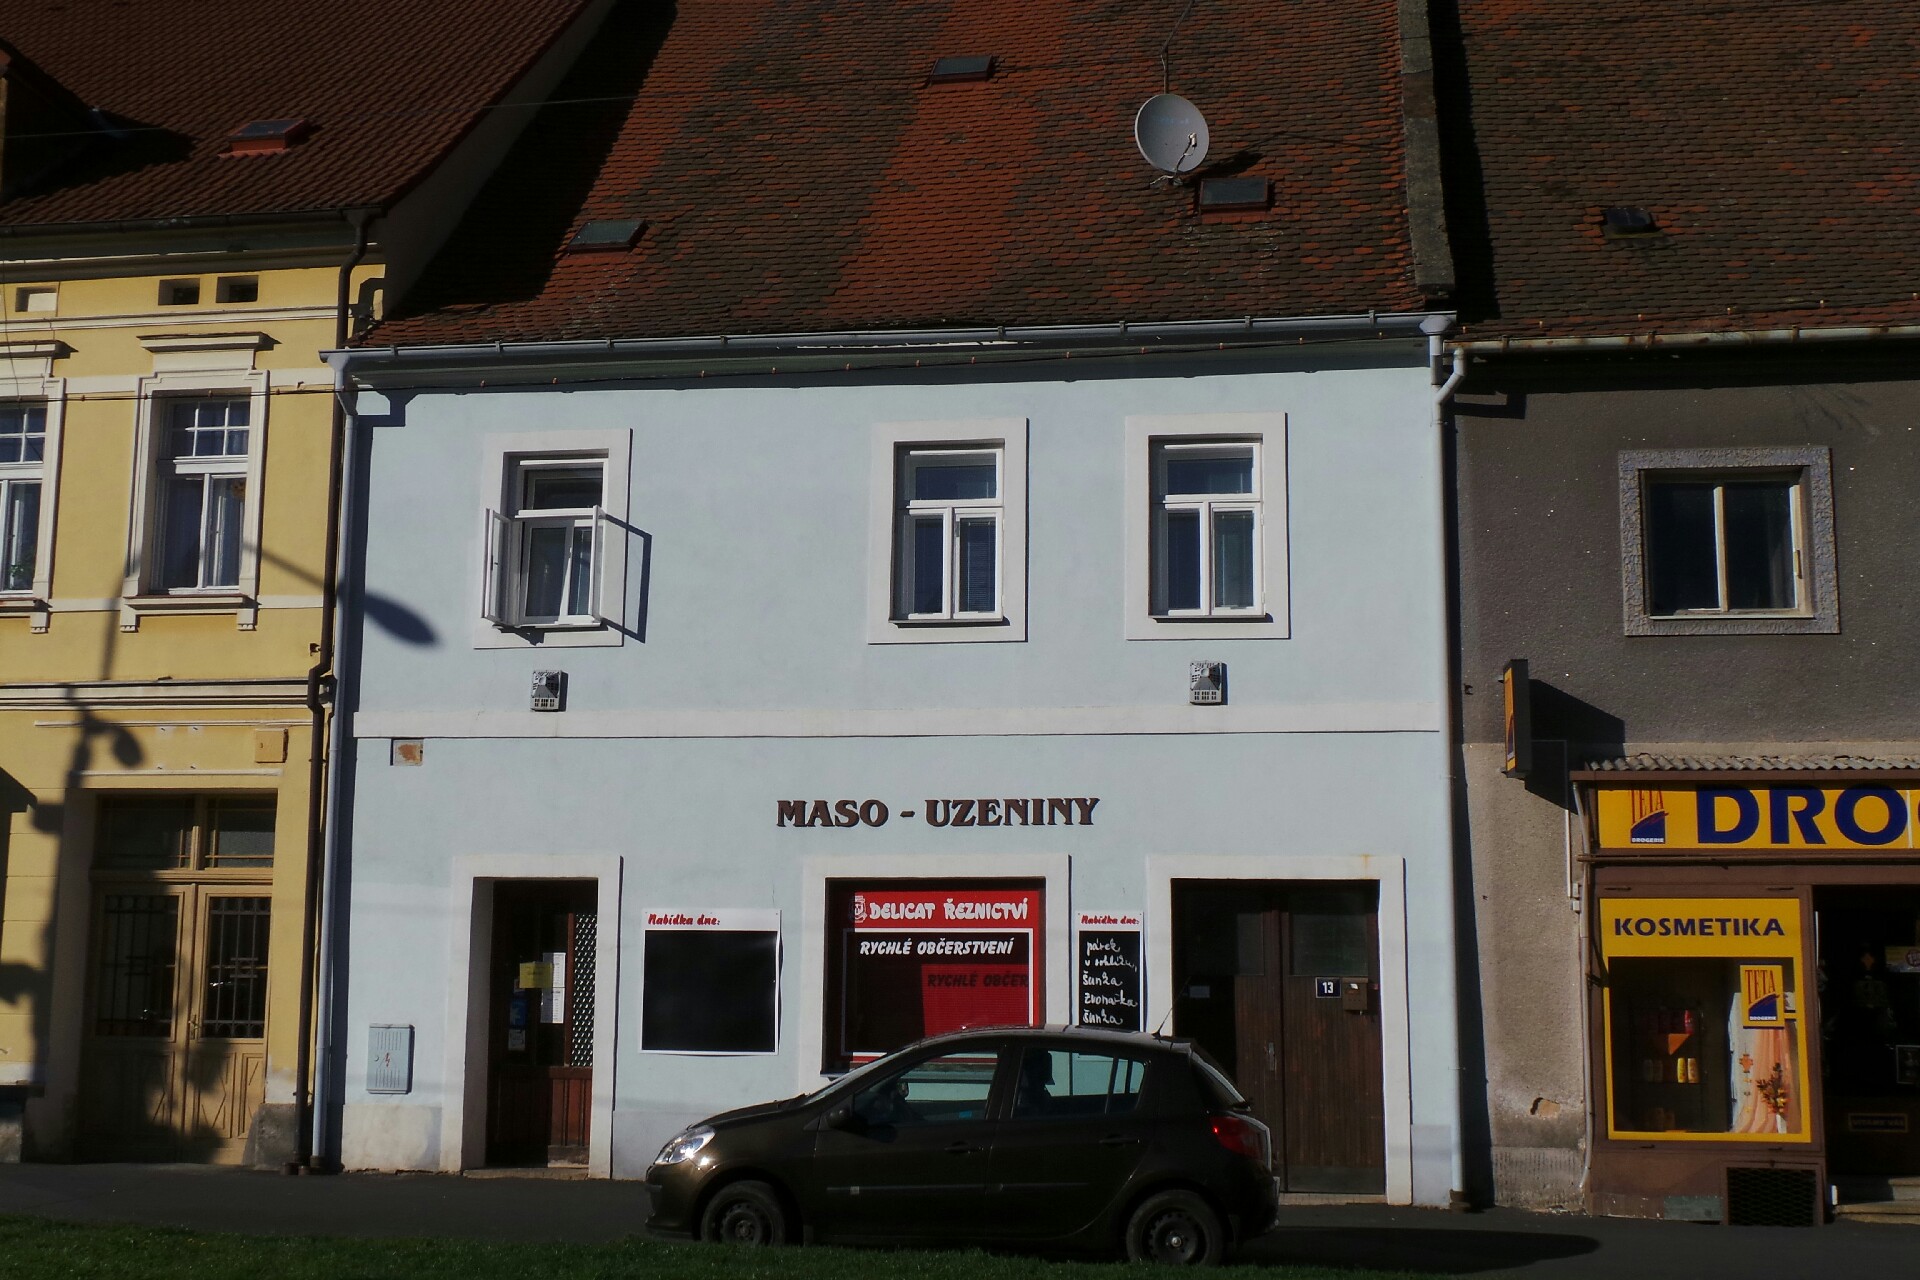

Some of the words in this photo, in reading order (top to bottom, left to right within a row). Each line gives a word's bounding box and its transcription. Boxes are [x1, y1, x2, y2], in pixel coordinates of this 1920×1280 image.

[777, 800, 888, 827] MASO
[925, 798, 1100, 827] UZENINY
[1696, 784, 1920, 845] DRO
[869, 902, 935, 920] DELICAT
[944, 898, 1028, 920] ŘEZNICTVÍ
[648, 913, 693, 926] Nabídka
[697, 914, 720, 926] dne:
[1081, 914, 1118, 925] Nabídka
[1614, 918, 1785, 936] KOSMETIKA
[860, 938, 912, 955] RYCHLÉ
[917, 937, 1014, 956] OBČERSTVENÍ
[1086, 938, 1121, 957] párek
[1322, 981, 1333, 994] 13
[1745, 969, 1776, 1005] TETA
